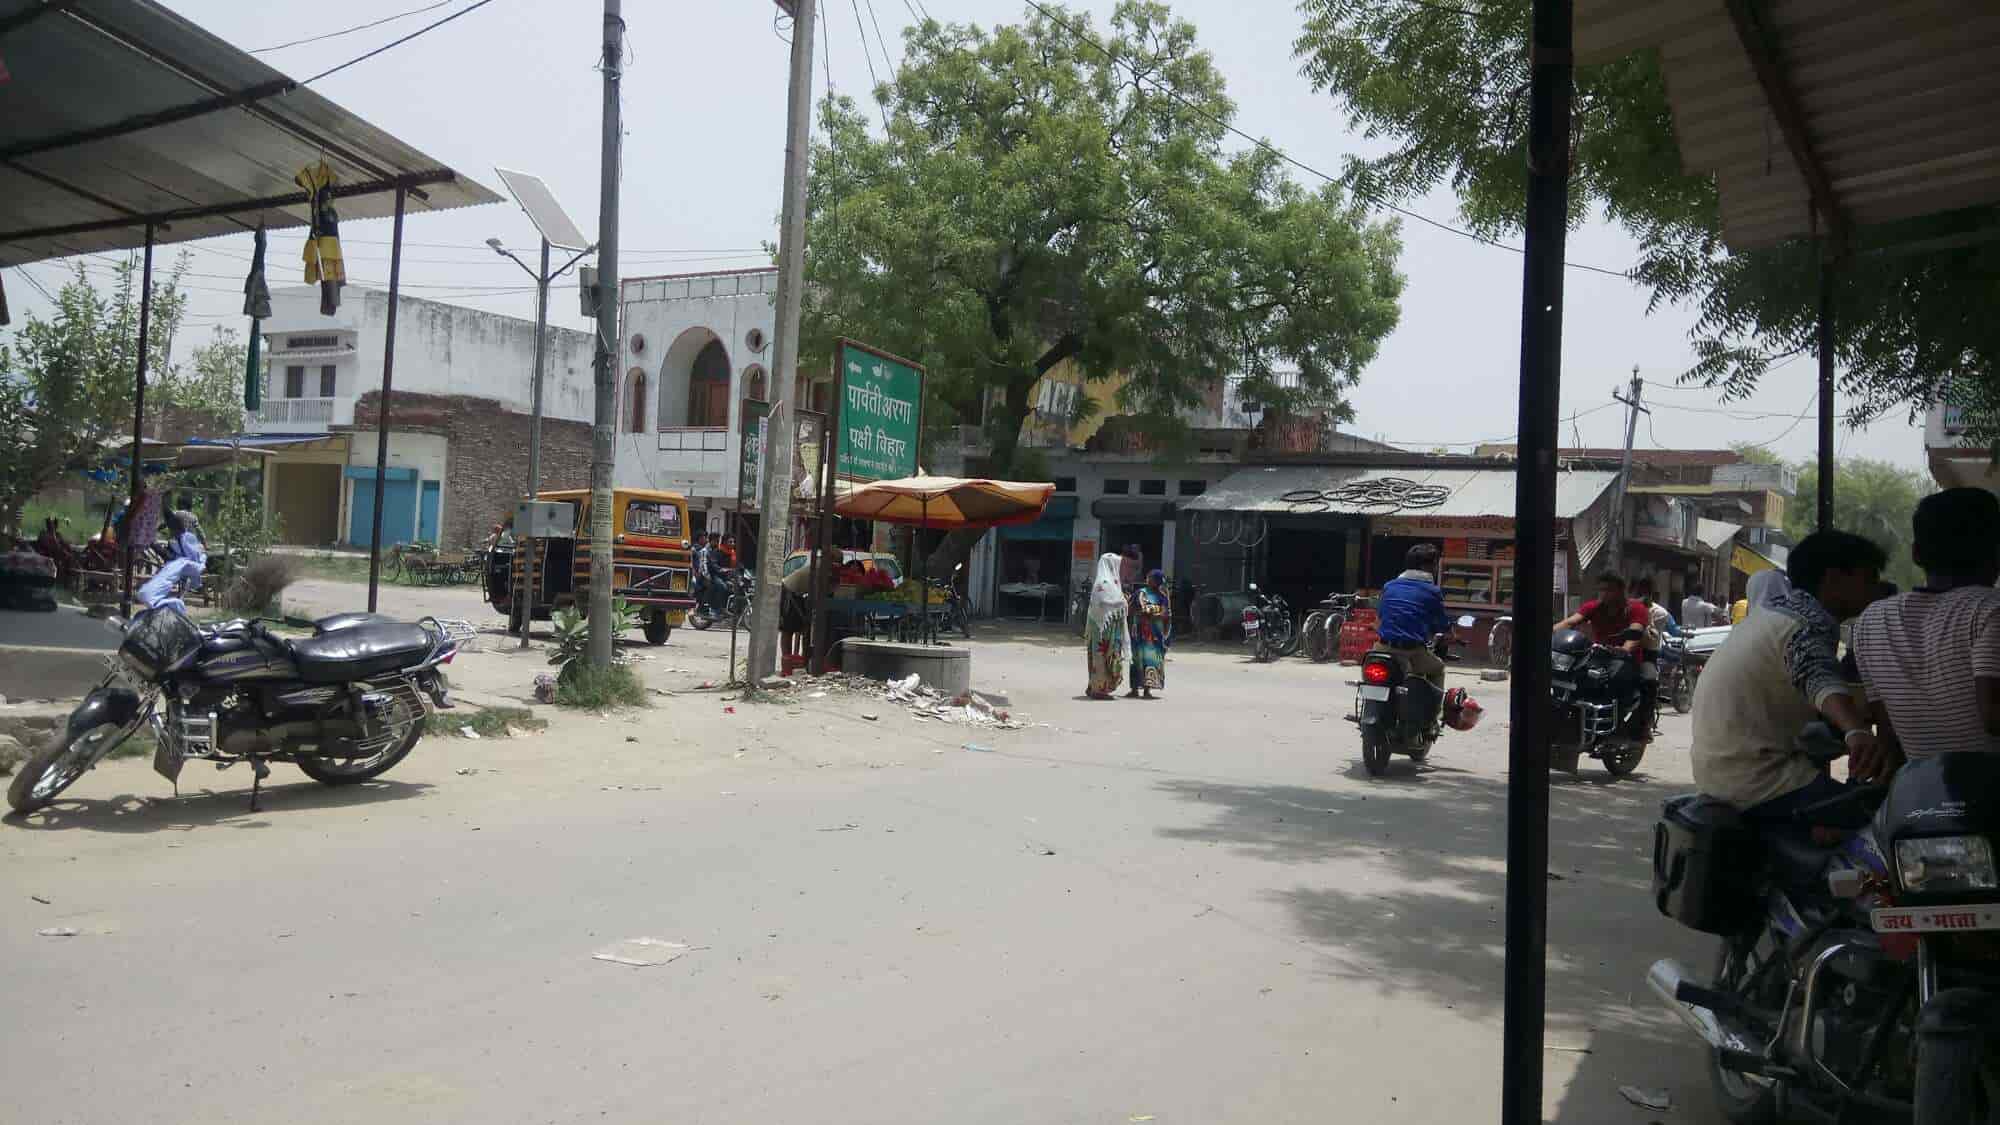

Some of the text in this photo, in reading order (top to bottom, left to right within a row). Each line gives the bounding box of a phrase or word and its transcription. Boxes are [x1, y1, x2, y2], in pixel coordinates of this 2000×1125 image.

[849, 425, 906, 458] पक्षी विहार
[1880, 912, 1977, 929] जय माता
